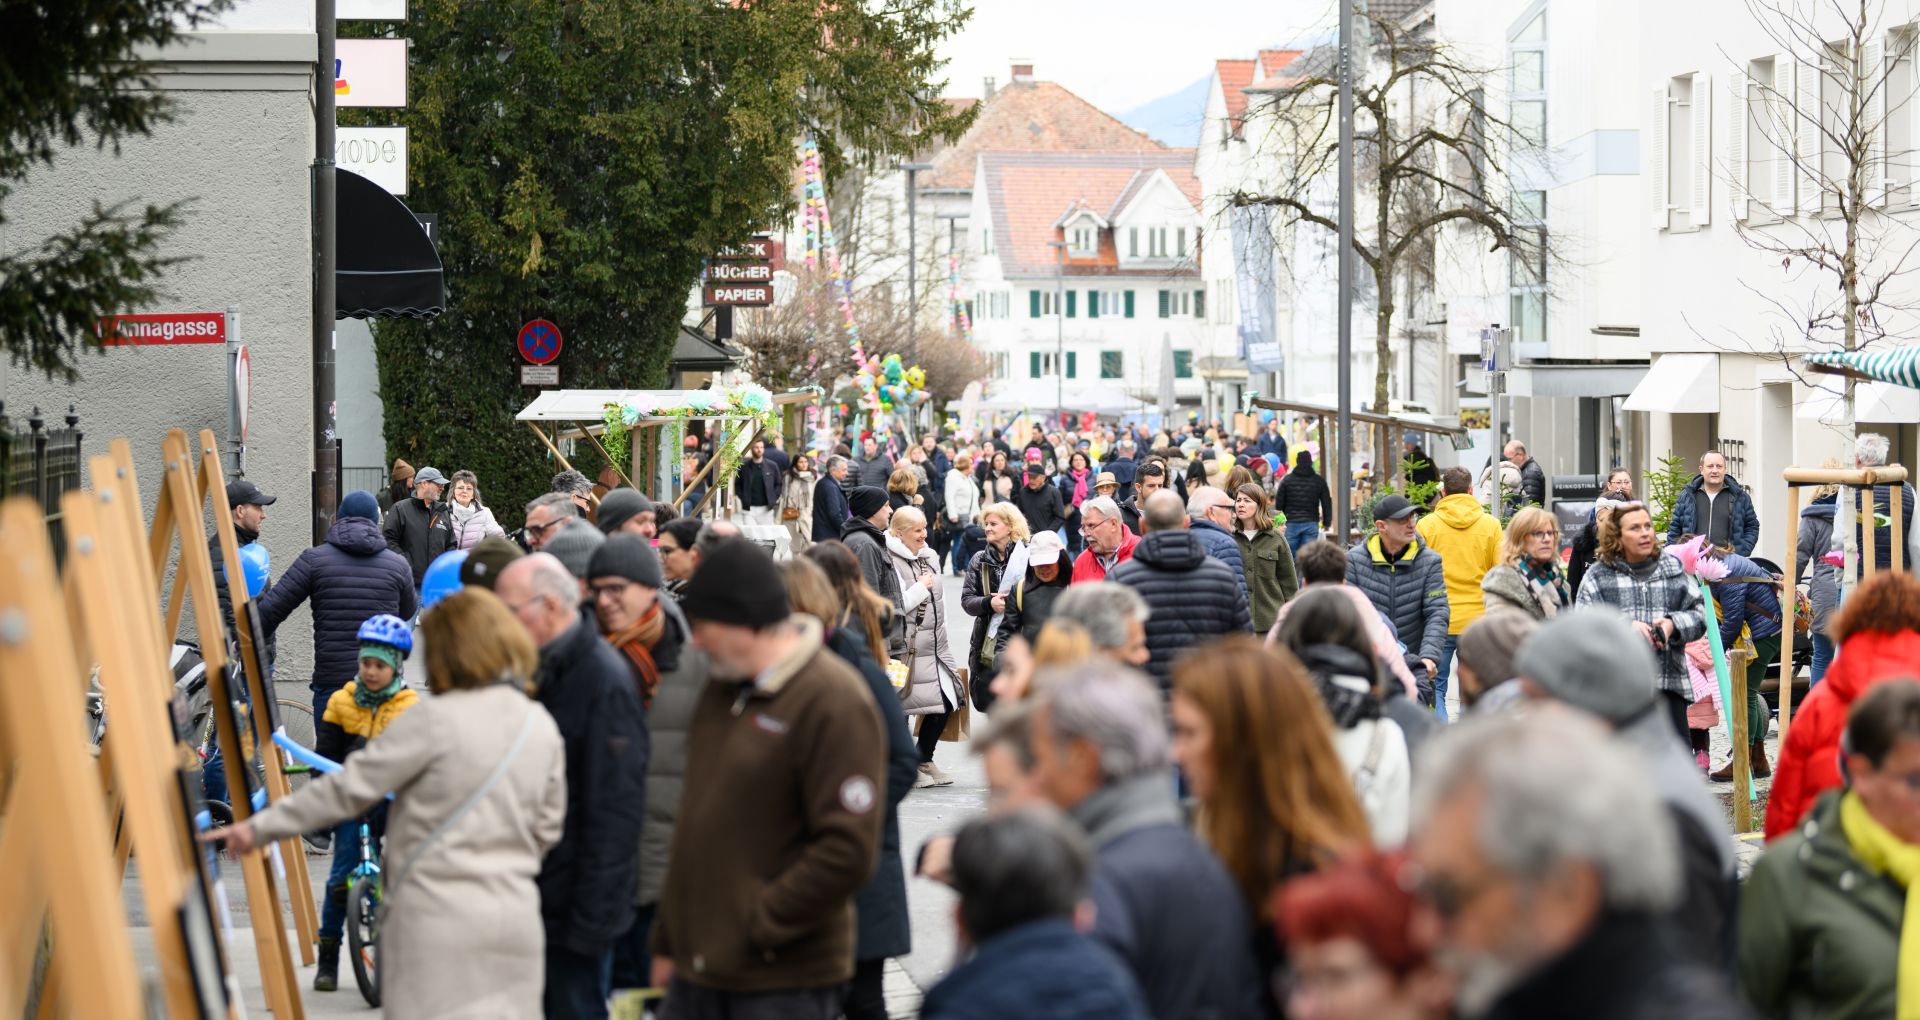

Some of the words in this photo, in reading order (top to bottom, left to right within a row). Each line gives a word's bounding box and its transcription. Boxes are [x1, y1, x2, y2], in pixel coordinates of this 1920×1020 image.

[710, 264, 770, 279] BÜCHER
[714, 288, 766, 301] PAPIER
[116, 319, 218, 341] Annagasse
